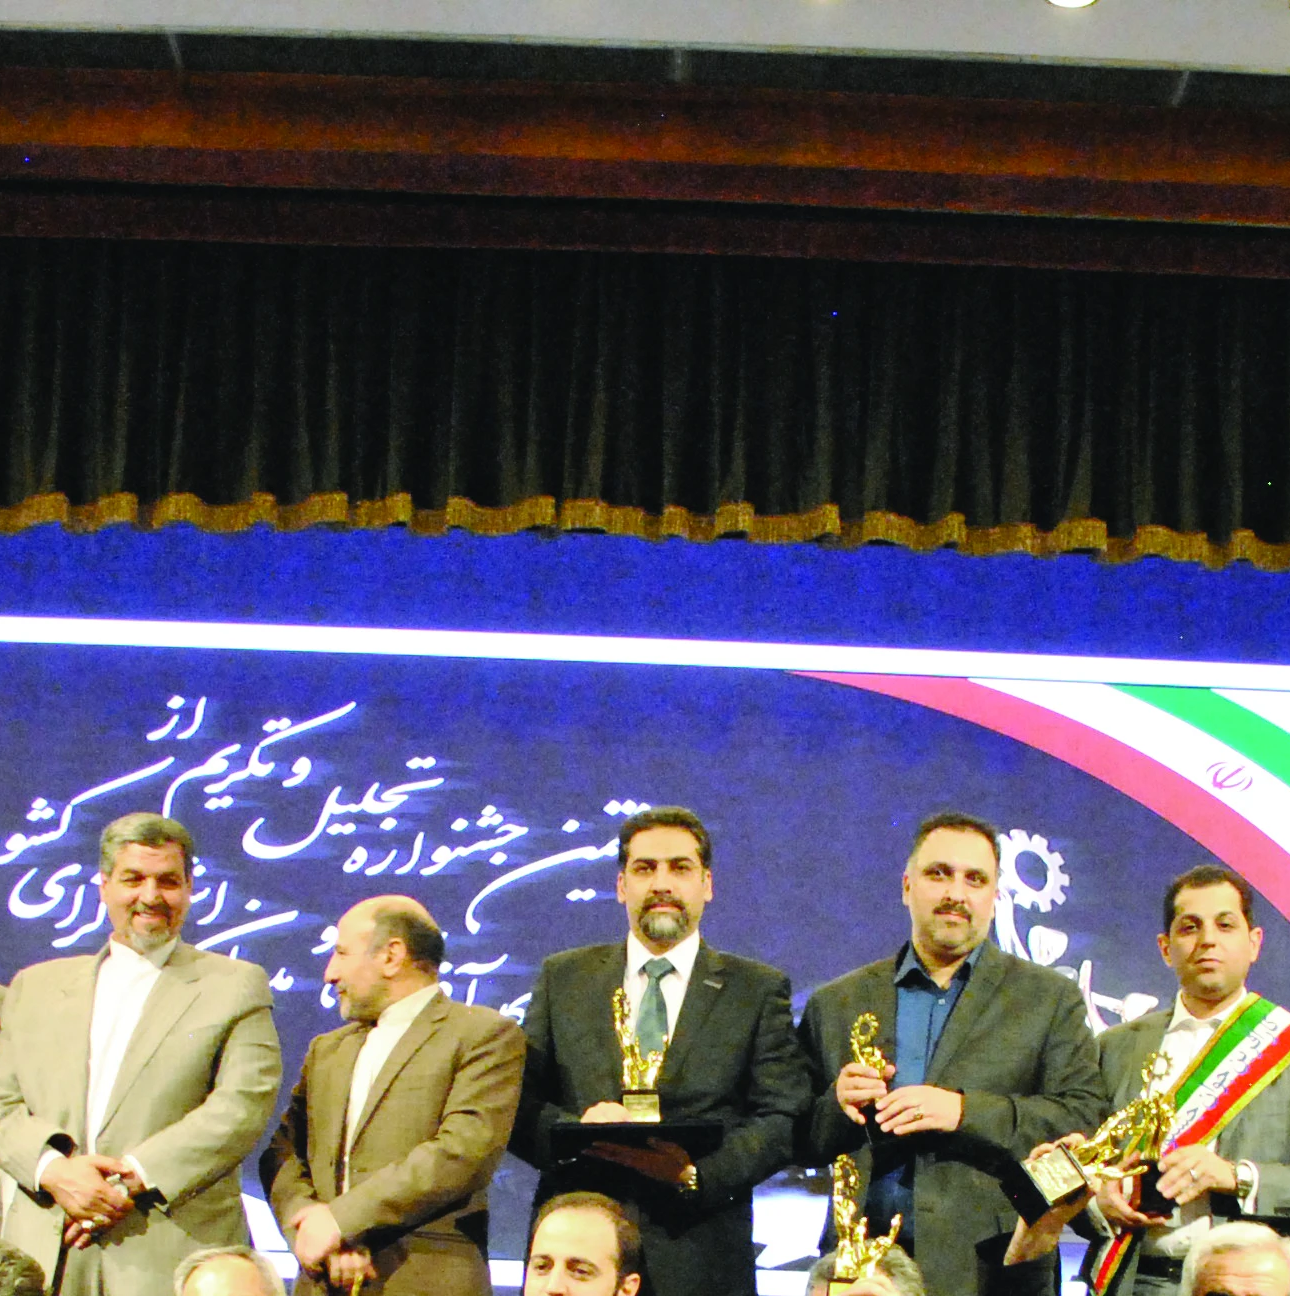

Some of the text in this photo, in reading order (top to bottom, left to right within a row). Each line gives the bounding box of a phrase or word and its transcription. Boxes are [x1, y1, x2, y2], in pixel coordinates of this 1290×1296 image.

[146, 694, 207, 741] از
[162, 701, 357, 818] تکریم
[282, 756, 312, 788] و
[241, 756, 445, 859] تجلیل
[342, 804, 529, 876] جشنواره
